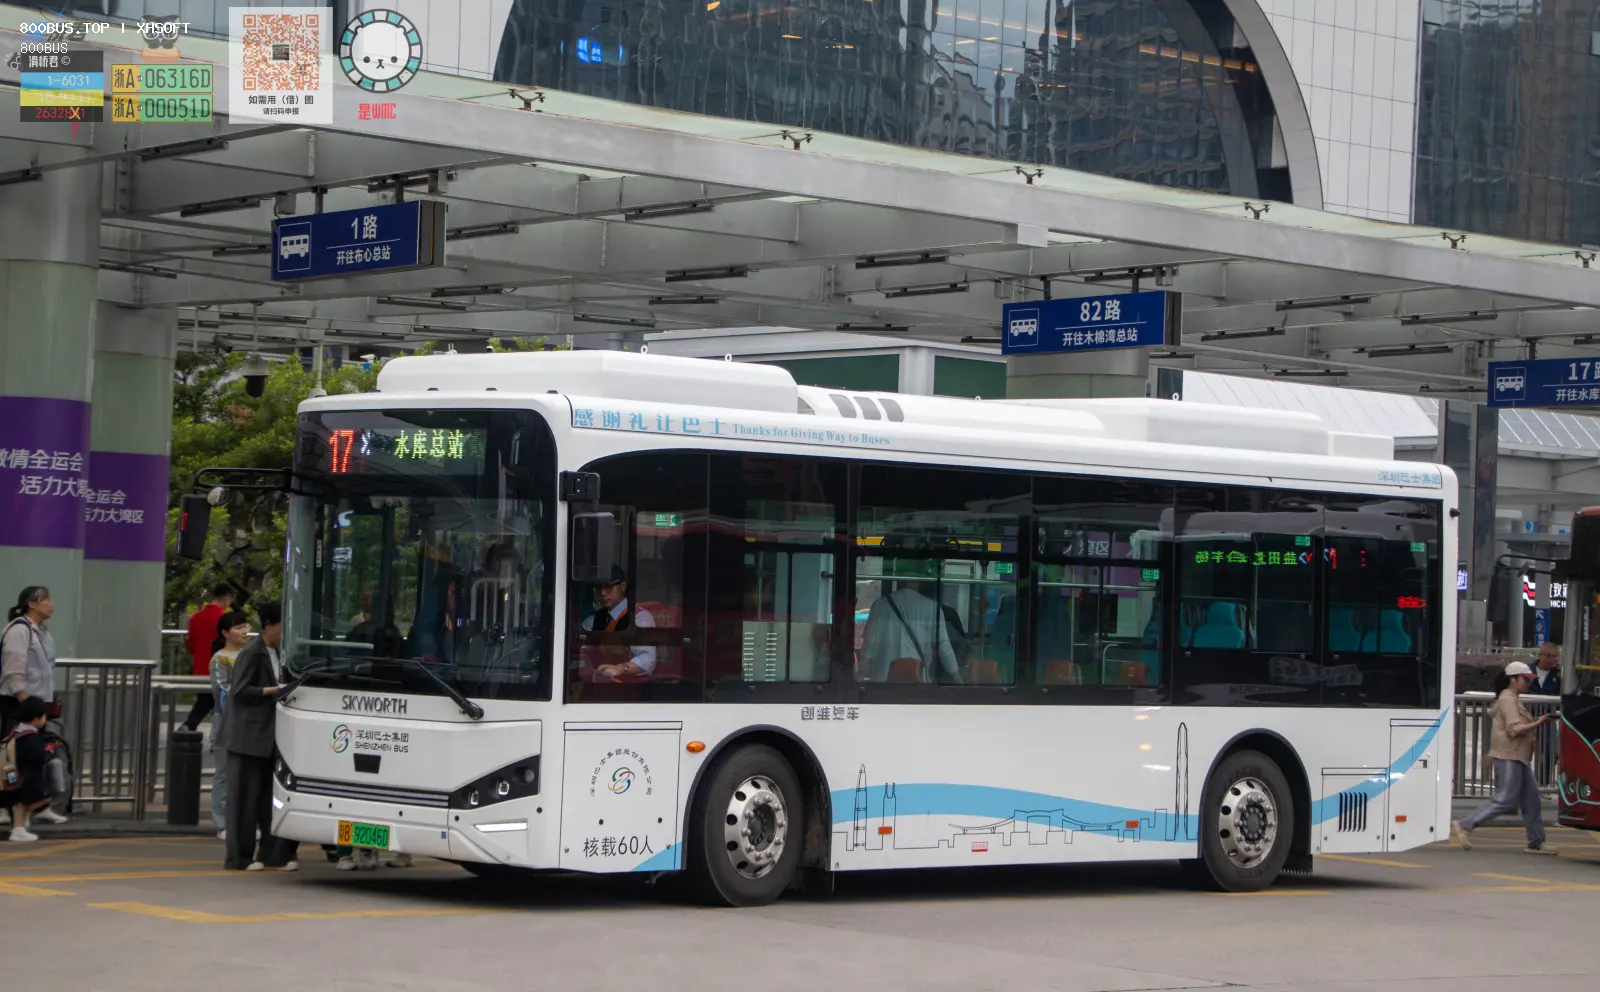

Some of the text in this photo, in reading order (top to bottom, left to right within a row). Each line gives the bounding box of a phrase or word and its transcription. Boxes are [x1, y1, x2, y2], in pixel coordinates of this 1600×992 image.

[351, 214, 378, 240] 1路
[336, 245, 391, 266] 开往布心总站
[1080, 299, 1121, 322] 82路
[1062, 327, 1138, 347] 开往木棉湾总站
[1556, 388, 1600, 402] 开往水库
[574, 408, 726, 436] 感谢礼让巴士
[394, 429, 465, 459] 水库总站
[732, 424, 890, 445] Thanks for Giving Way to Buses
[329, 430, 354, 473] 17
[1378, 471, 1441, 485] 深圳巴士集团
[341, 694, 408, 714] SKYWORTH
[801, 706, 860, 721] 创维汽车
[355, 729, 409, 743] 深圳巴士集团
[355, 741, 409, 753] SHENZHEN BUS
[583, 835, 654, 858] 核载60人
